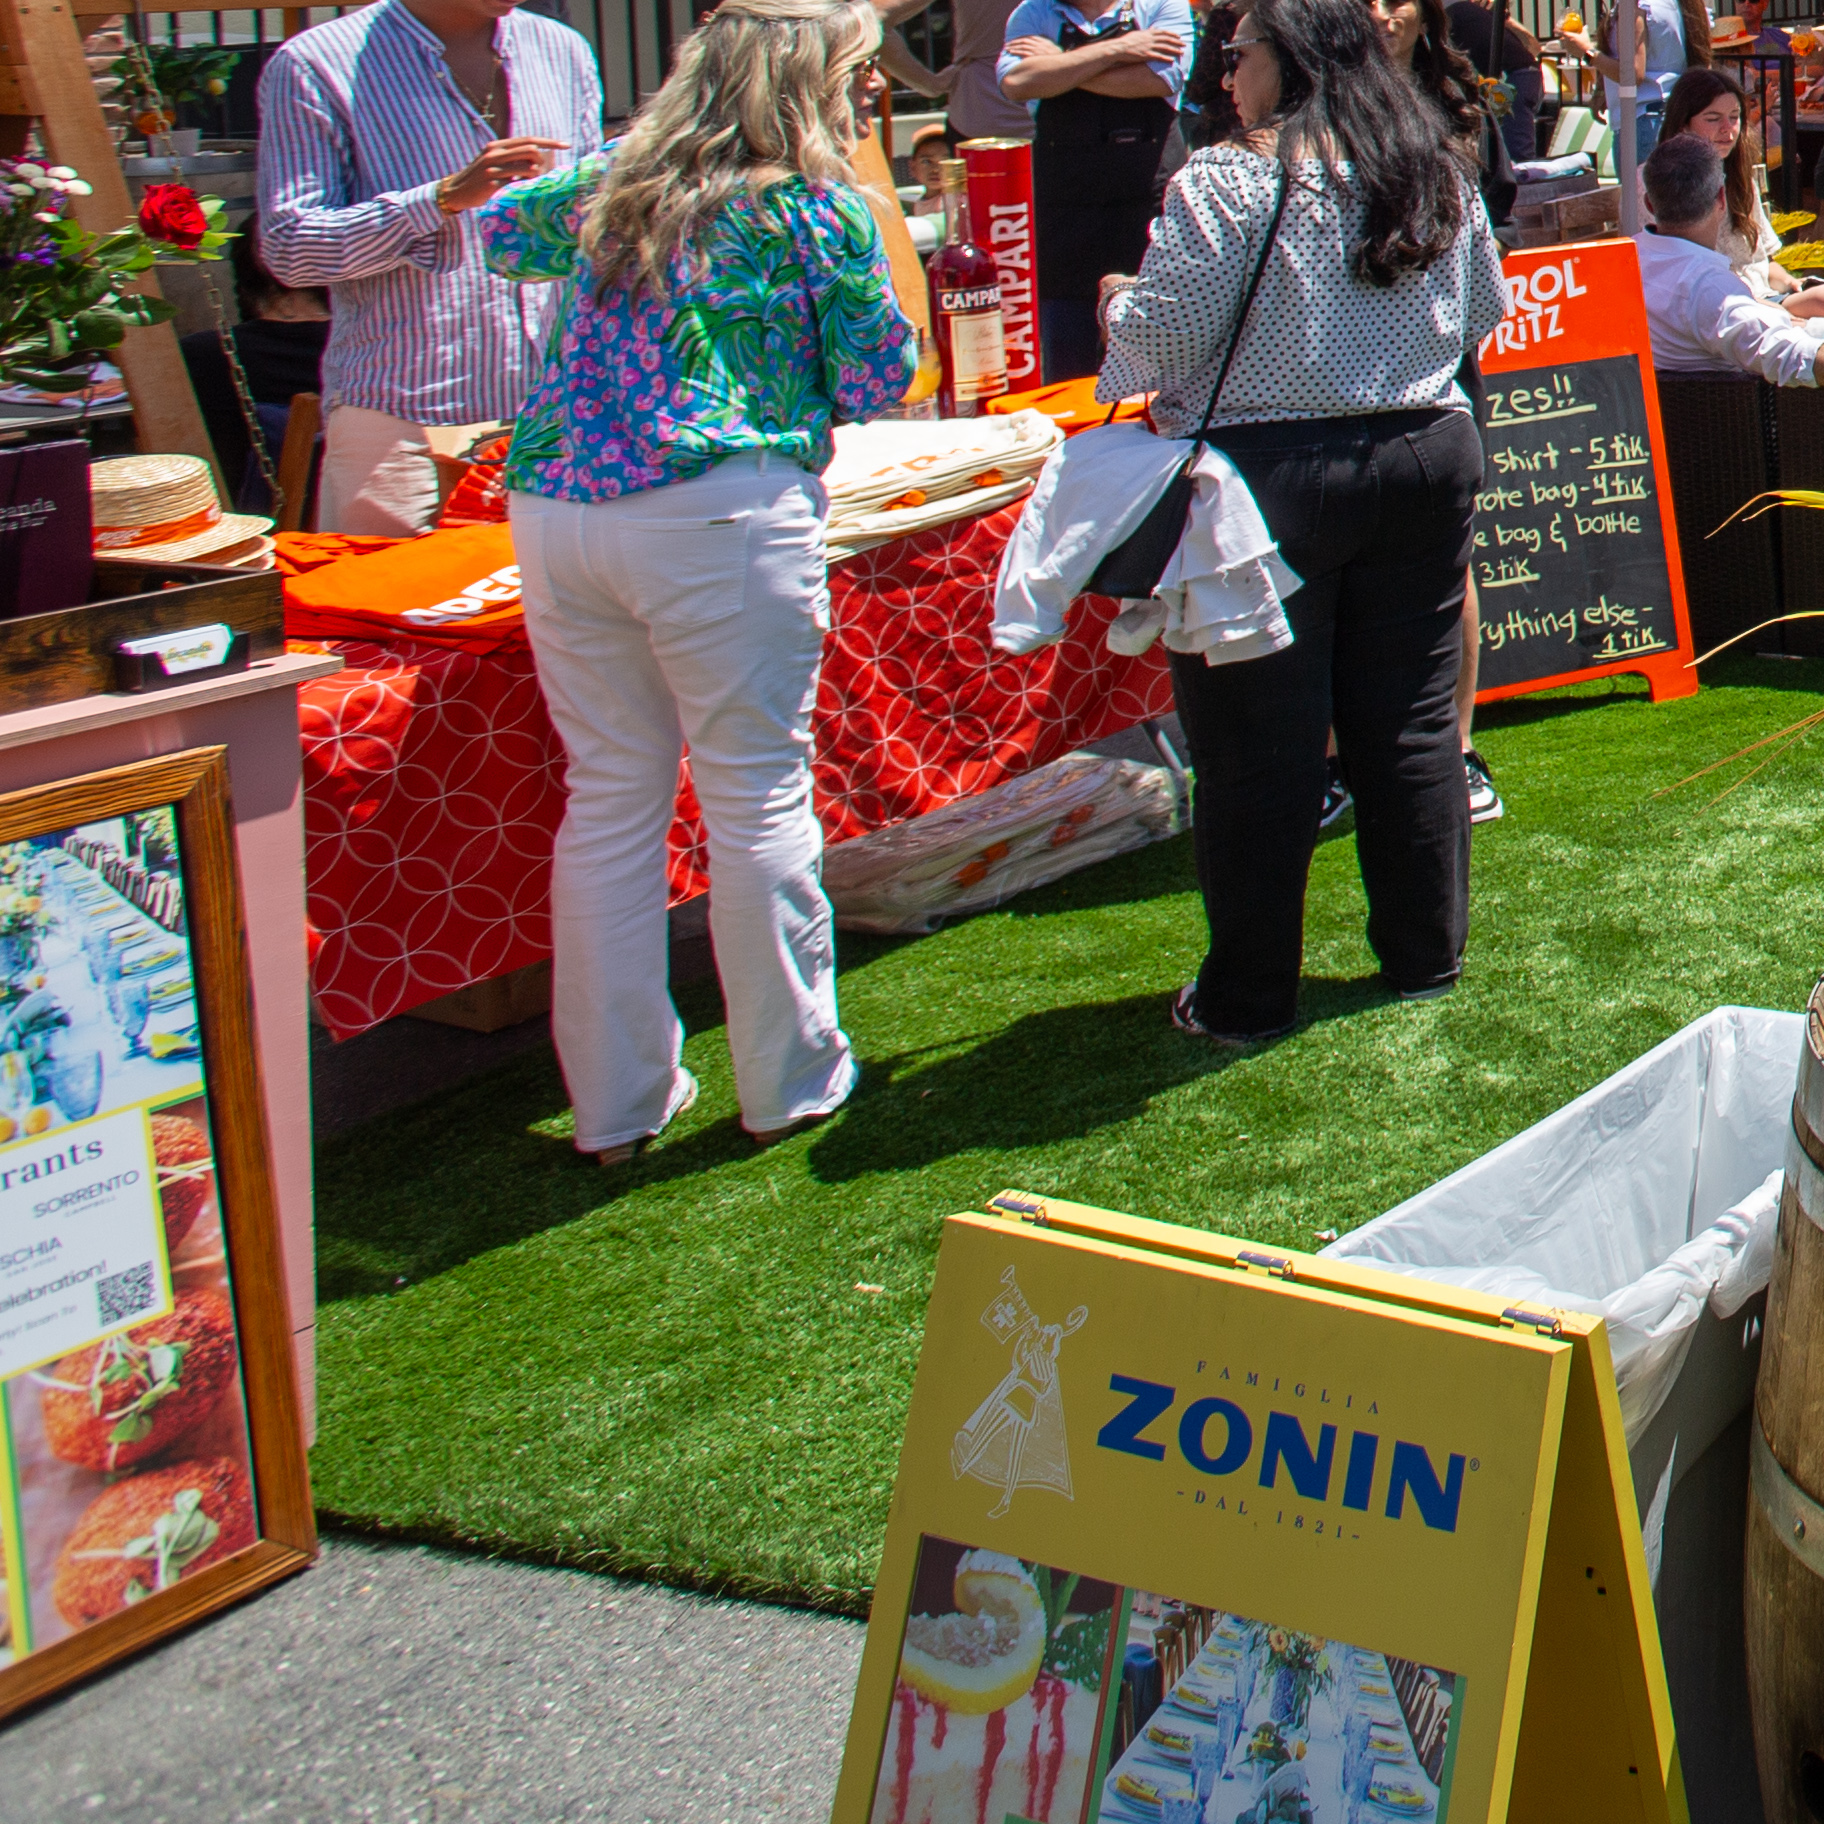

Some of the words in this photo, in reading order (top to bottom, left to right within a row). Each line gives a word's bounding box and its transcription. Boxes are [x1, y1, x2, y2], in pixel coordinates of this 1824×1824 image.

[989, 201, 1037, 381] CAMPARI
[1589, 436, 1607, 465] 5
[1592, 472, 1609, 498] 4
[1495, 523, 1541, 553] bag
[1574, 511, 1642, 536] bottle
[34, 1168, 140, 1219] SORRENTO
[1197, 1360, 1381, 1416] FAMIGLIA
[1096, 1372, 1467, 1534] ZONIN
